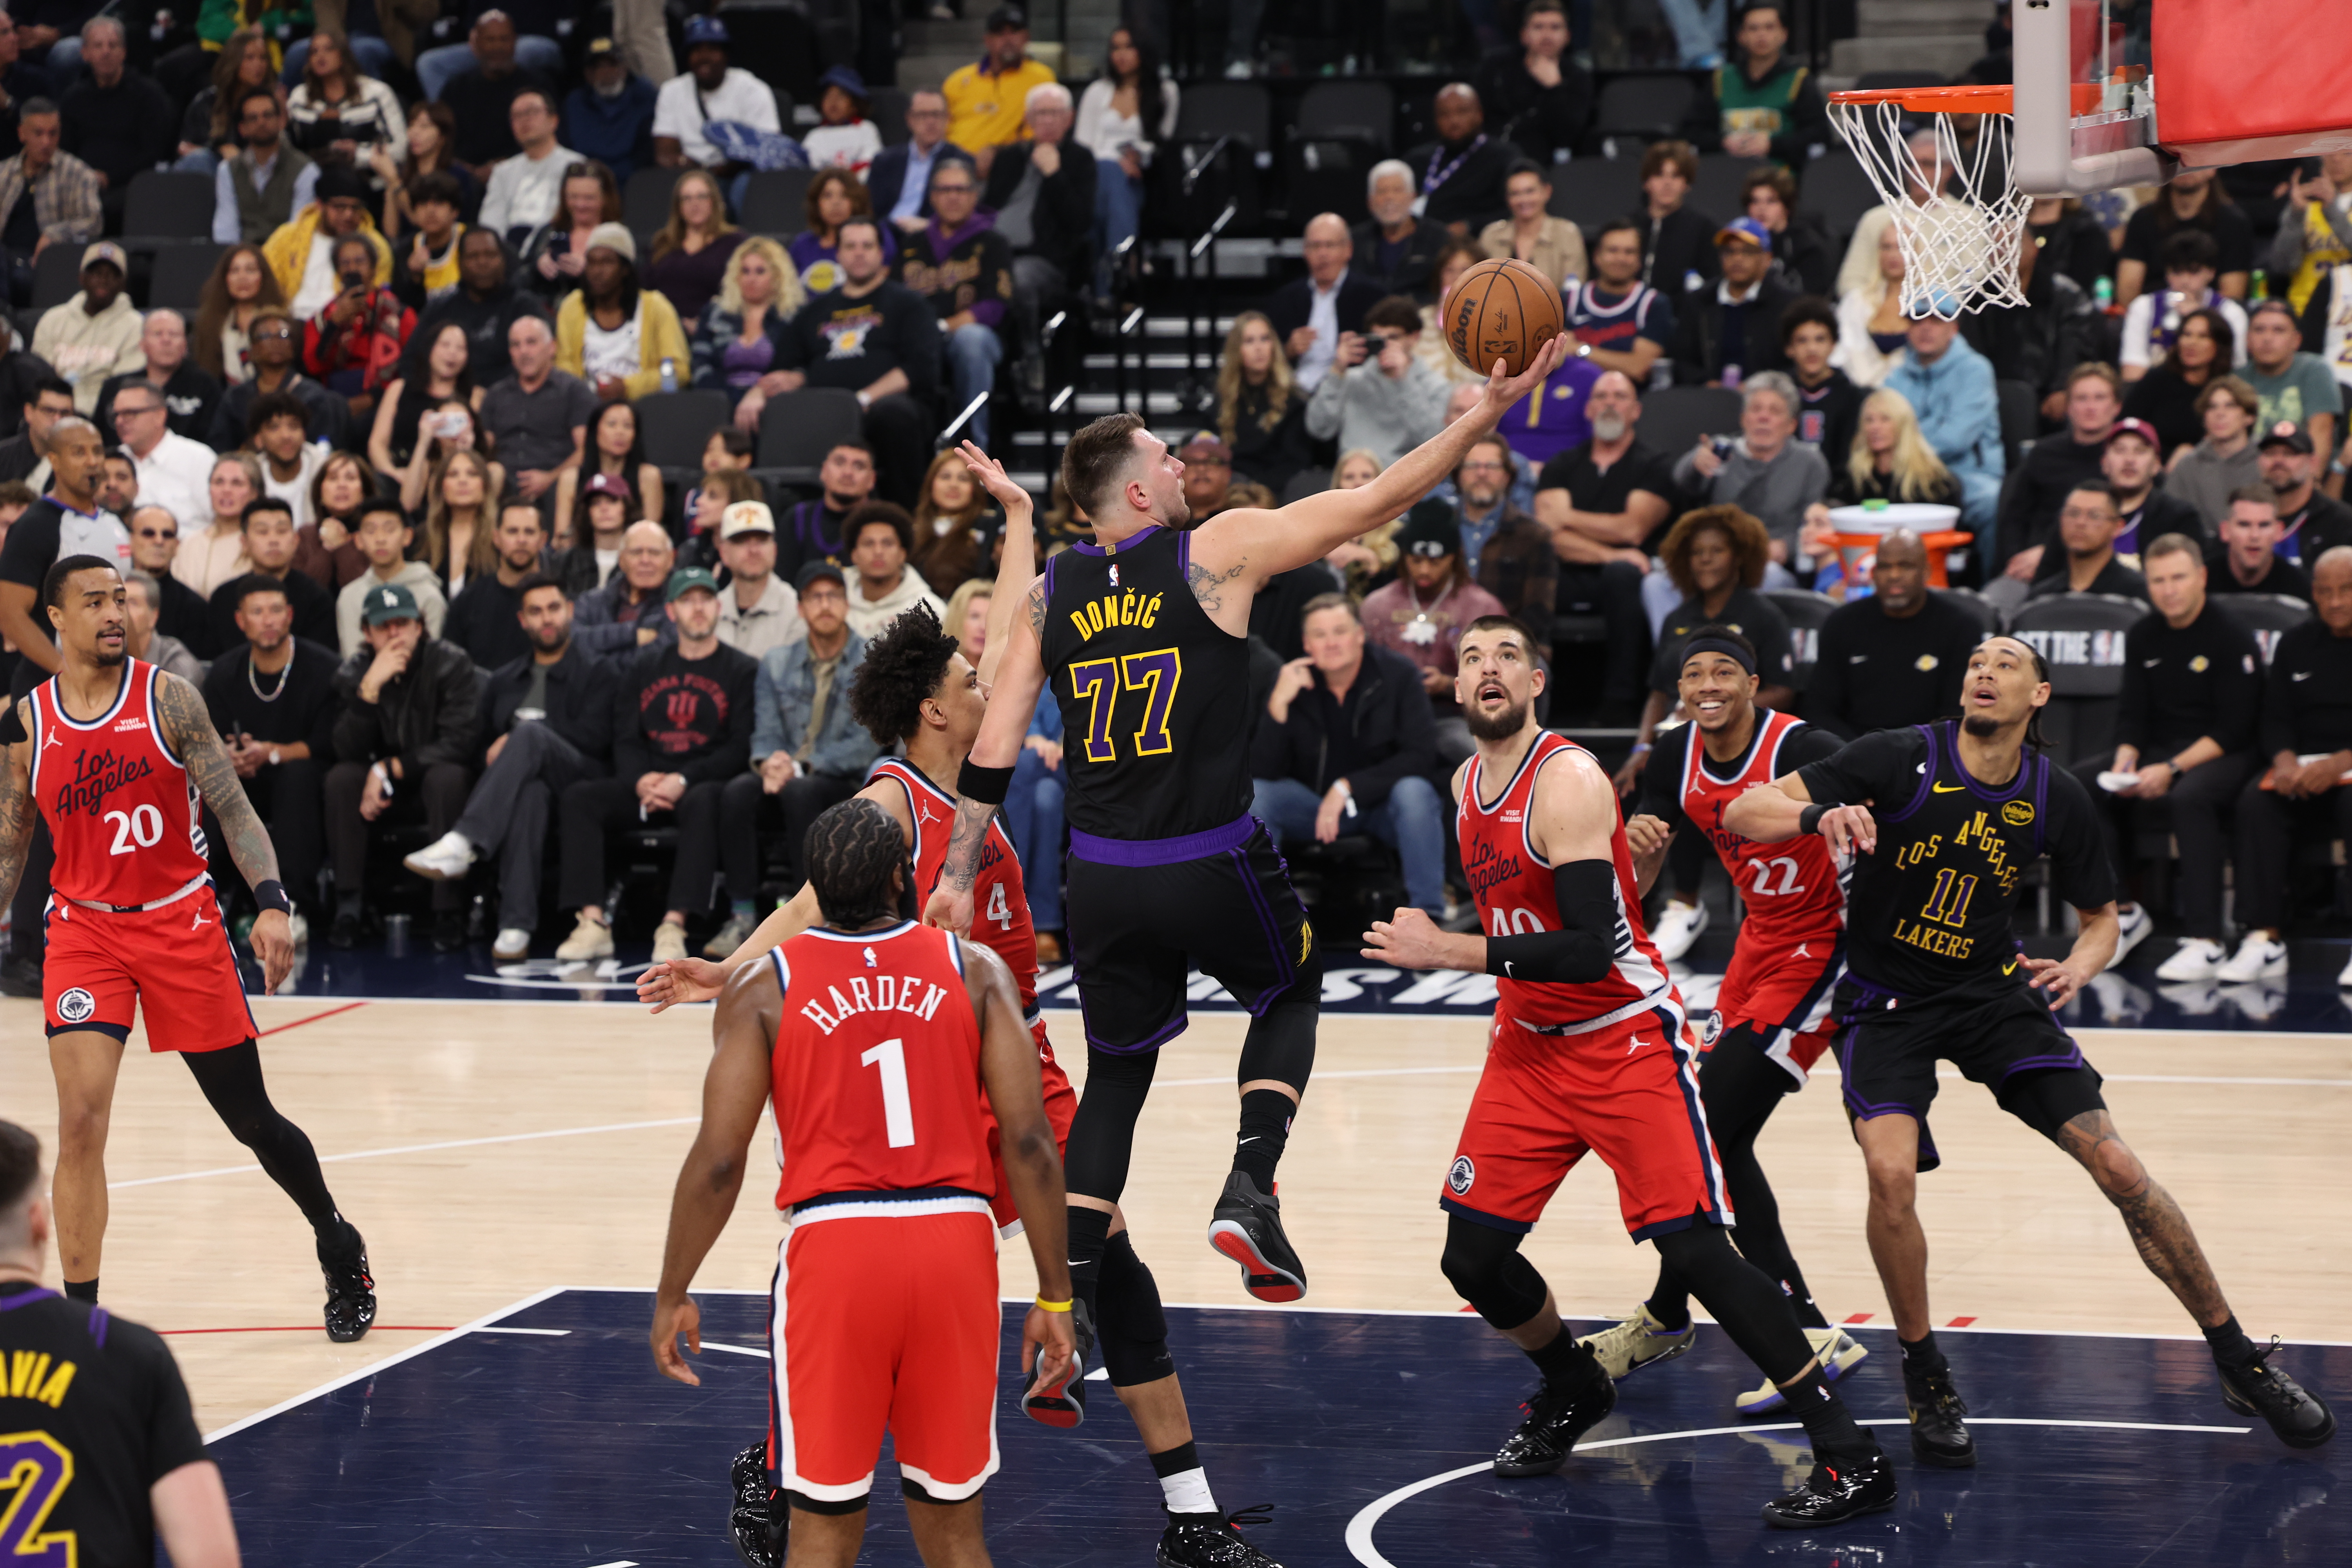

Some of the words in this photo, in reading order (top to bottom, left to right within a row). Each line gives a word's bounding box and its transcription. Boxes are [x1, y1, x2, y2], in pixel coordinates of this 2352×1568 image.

[1070, 587, 1163, 641] DONČIĆ
[114, 722, 147, 732] RWANDA
[120, 717, 139, 725] VISIT
[1069, 647, 1181, 762] 77
[56, 755, 153, 821] Angeles
[74, 748, 116, 785] Los
[103, 804, 163, 856] 20
[1472, 831, 1496, 867] Los
[1895, 835, 1942, 870] LOS
[1954, 811, 2019, 896] ANGELES
[1748, 857, 1805, 895] 22
[1920, 867, 1979, 928] 11
[987, 883, 1012, 930] 4
[1893, 918, 1974, 959] LAKERS
[800, 976, 947, 1035] HARDEN
[861, 1038, 915, 1148] 1
[0, 1429, 78, 1568] 2
